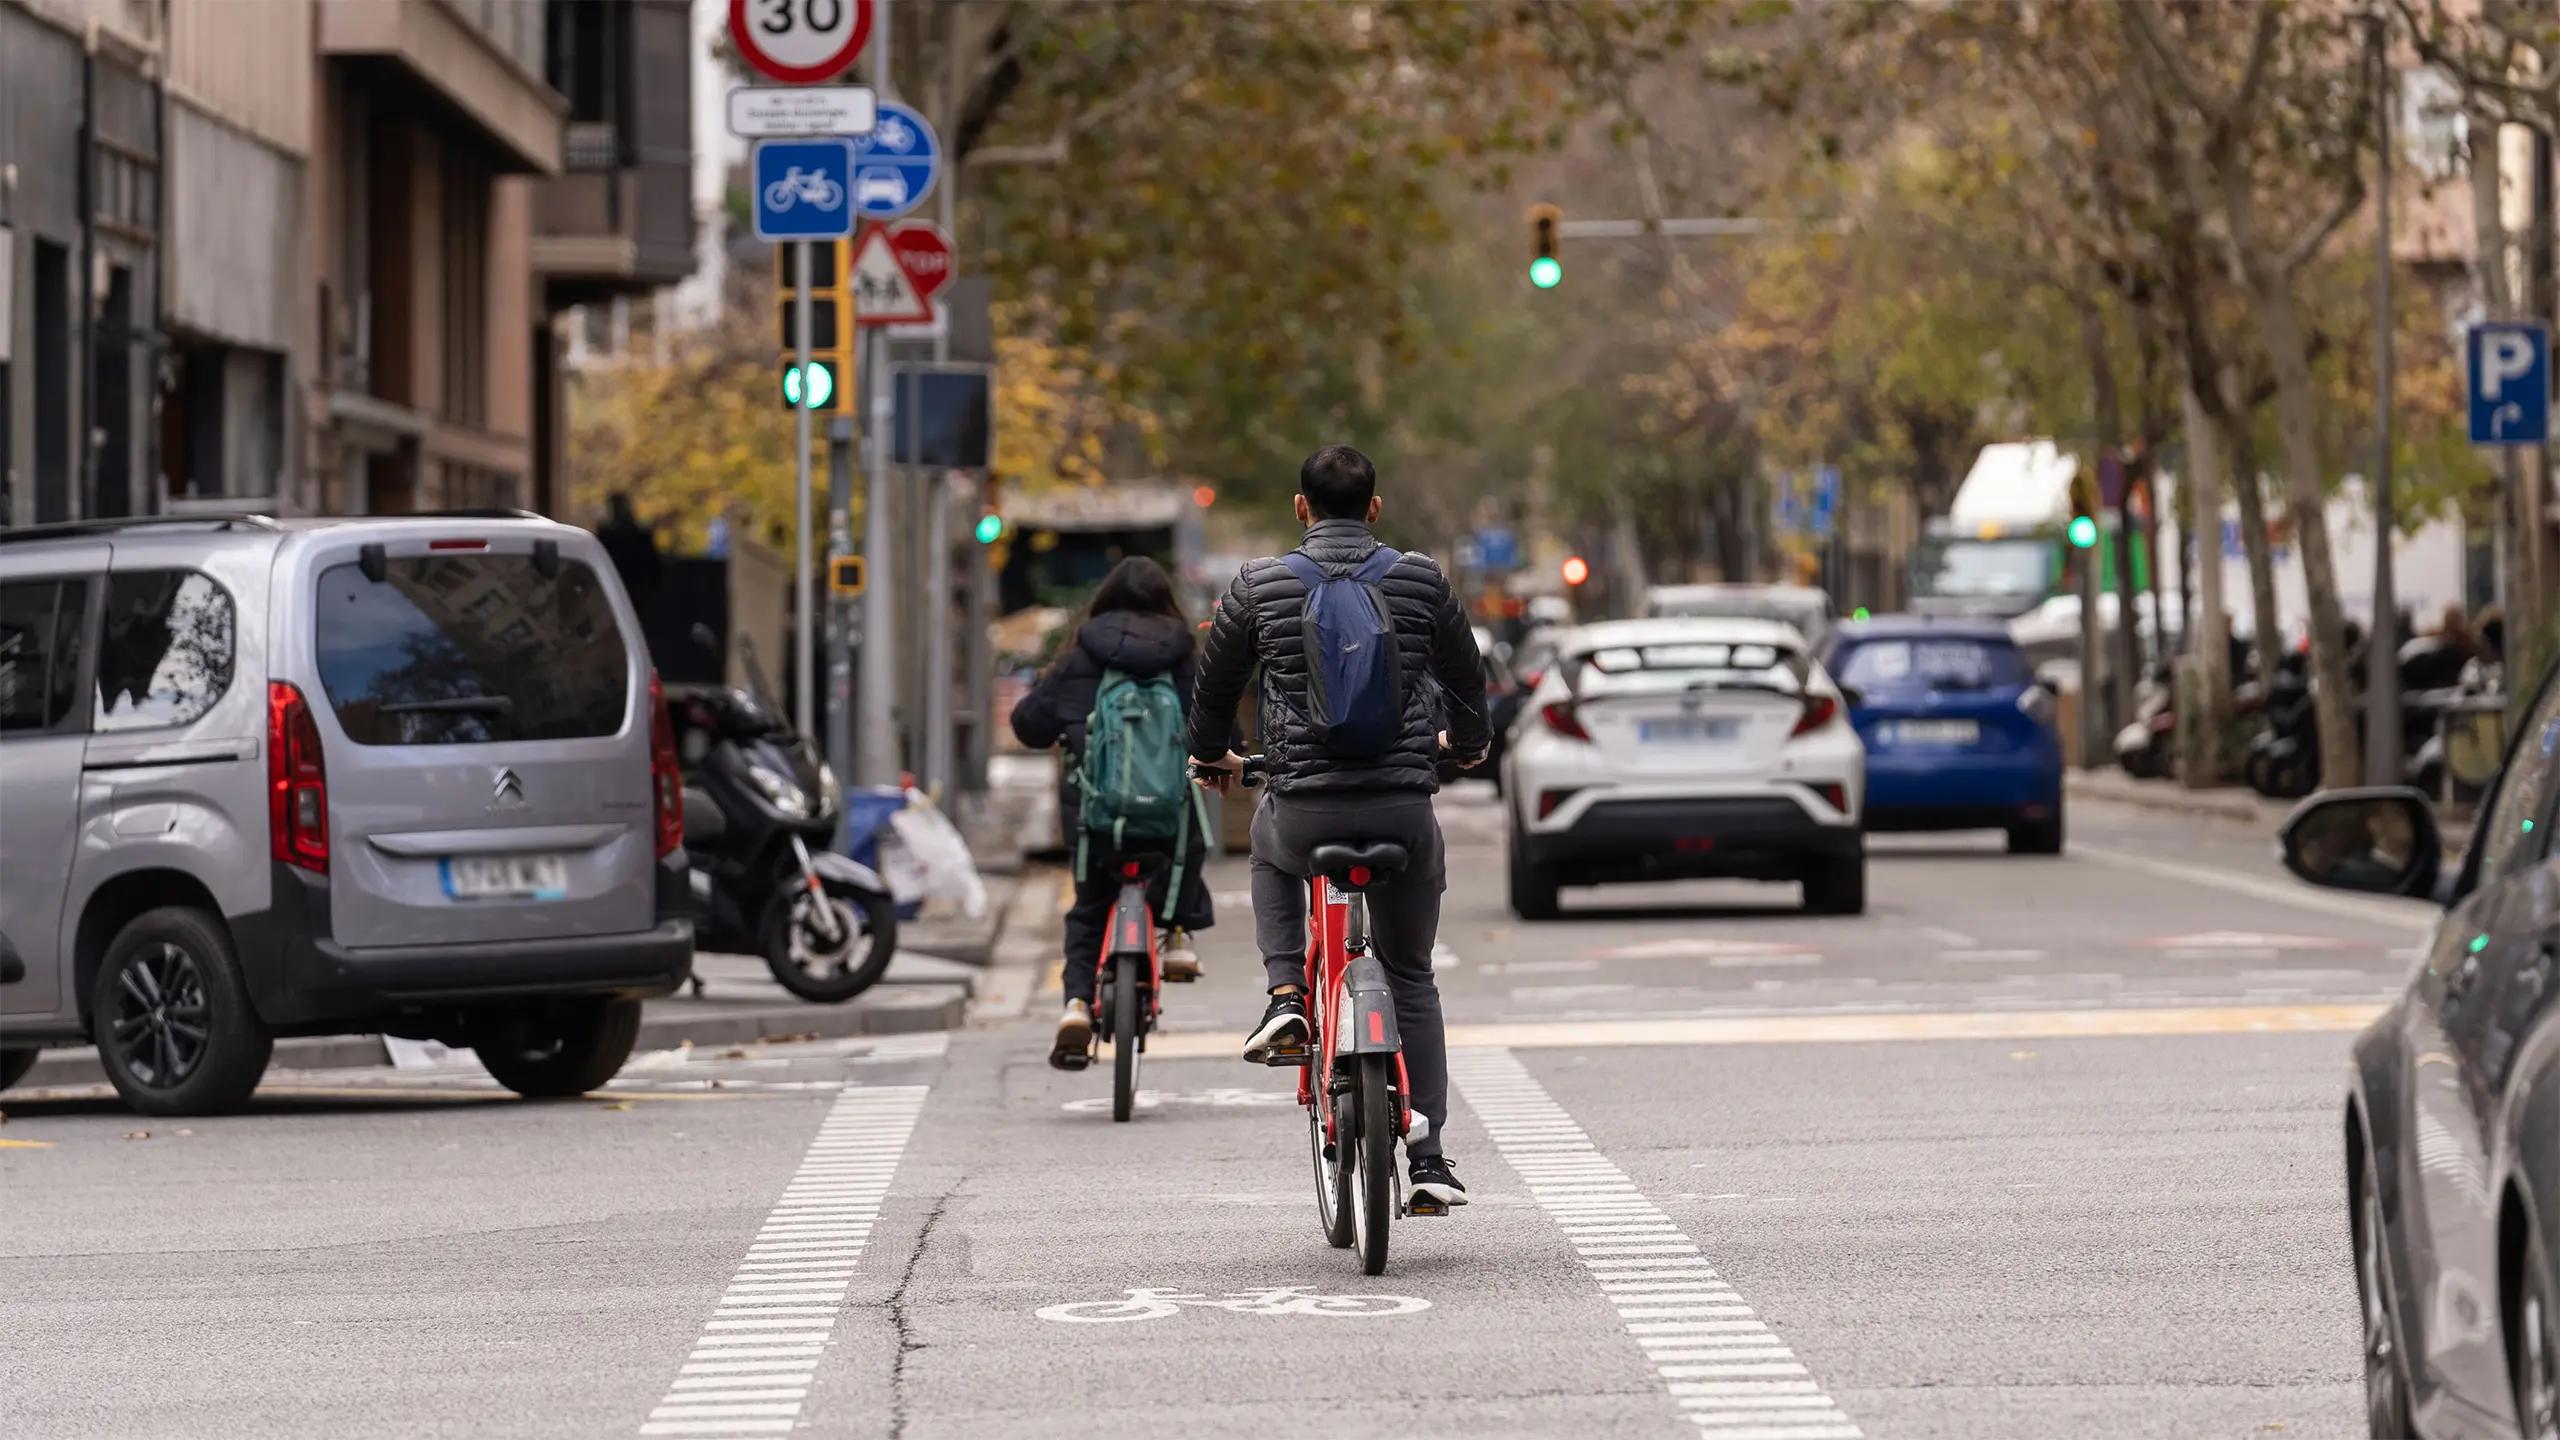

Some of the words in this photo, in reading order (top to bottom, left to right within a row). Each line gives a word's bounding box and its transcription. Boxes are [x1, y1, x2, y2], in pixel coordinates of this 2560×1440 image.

[761, 0, 841, 33] 30
[901, 250, 947, 274] TOP
[2481, 332, 2534, 400] P
